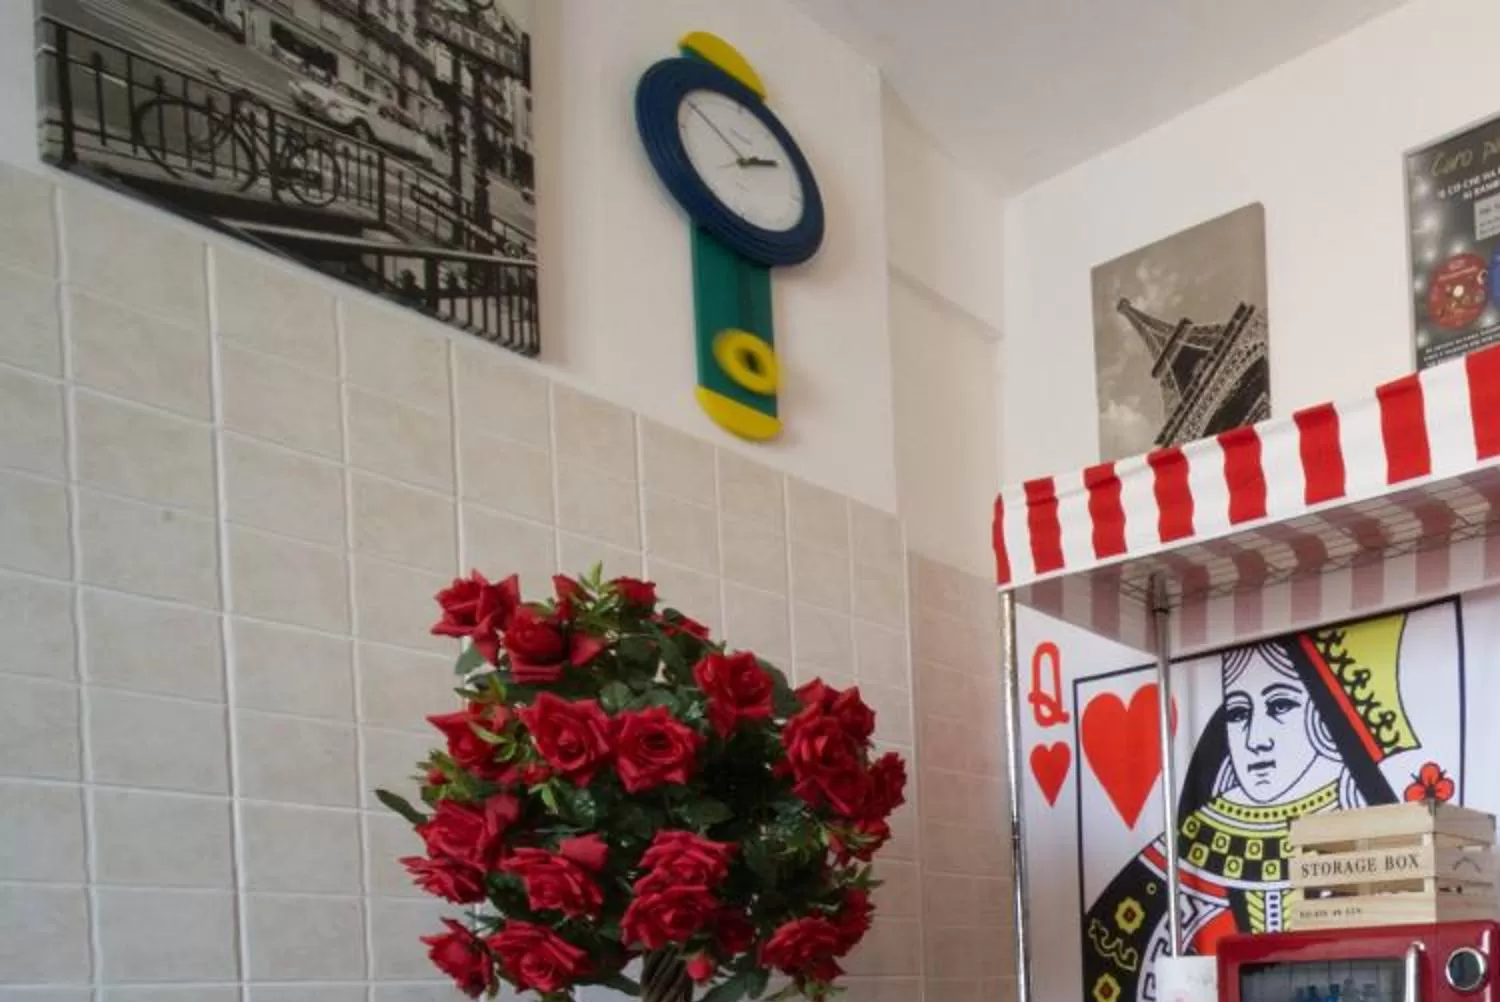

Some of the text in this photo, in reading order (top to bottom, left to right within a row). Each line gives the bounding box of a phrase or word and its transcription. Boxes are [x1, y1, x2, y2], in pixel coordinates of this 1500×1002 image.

[1028, 641, 1070, 728] Q
[1301, 853, 1419, 878] STORAGE BOX
